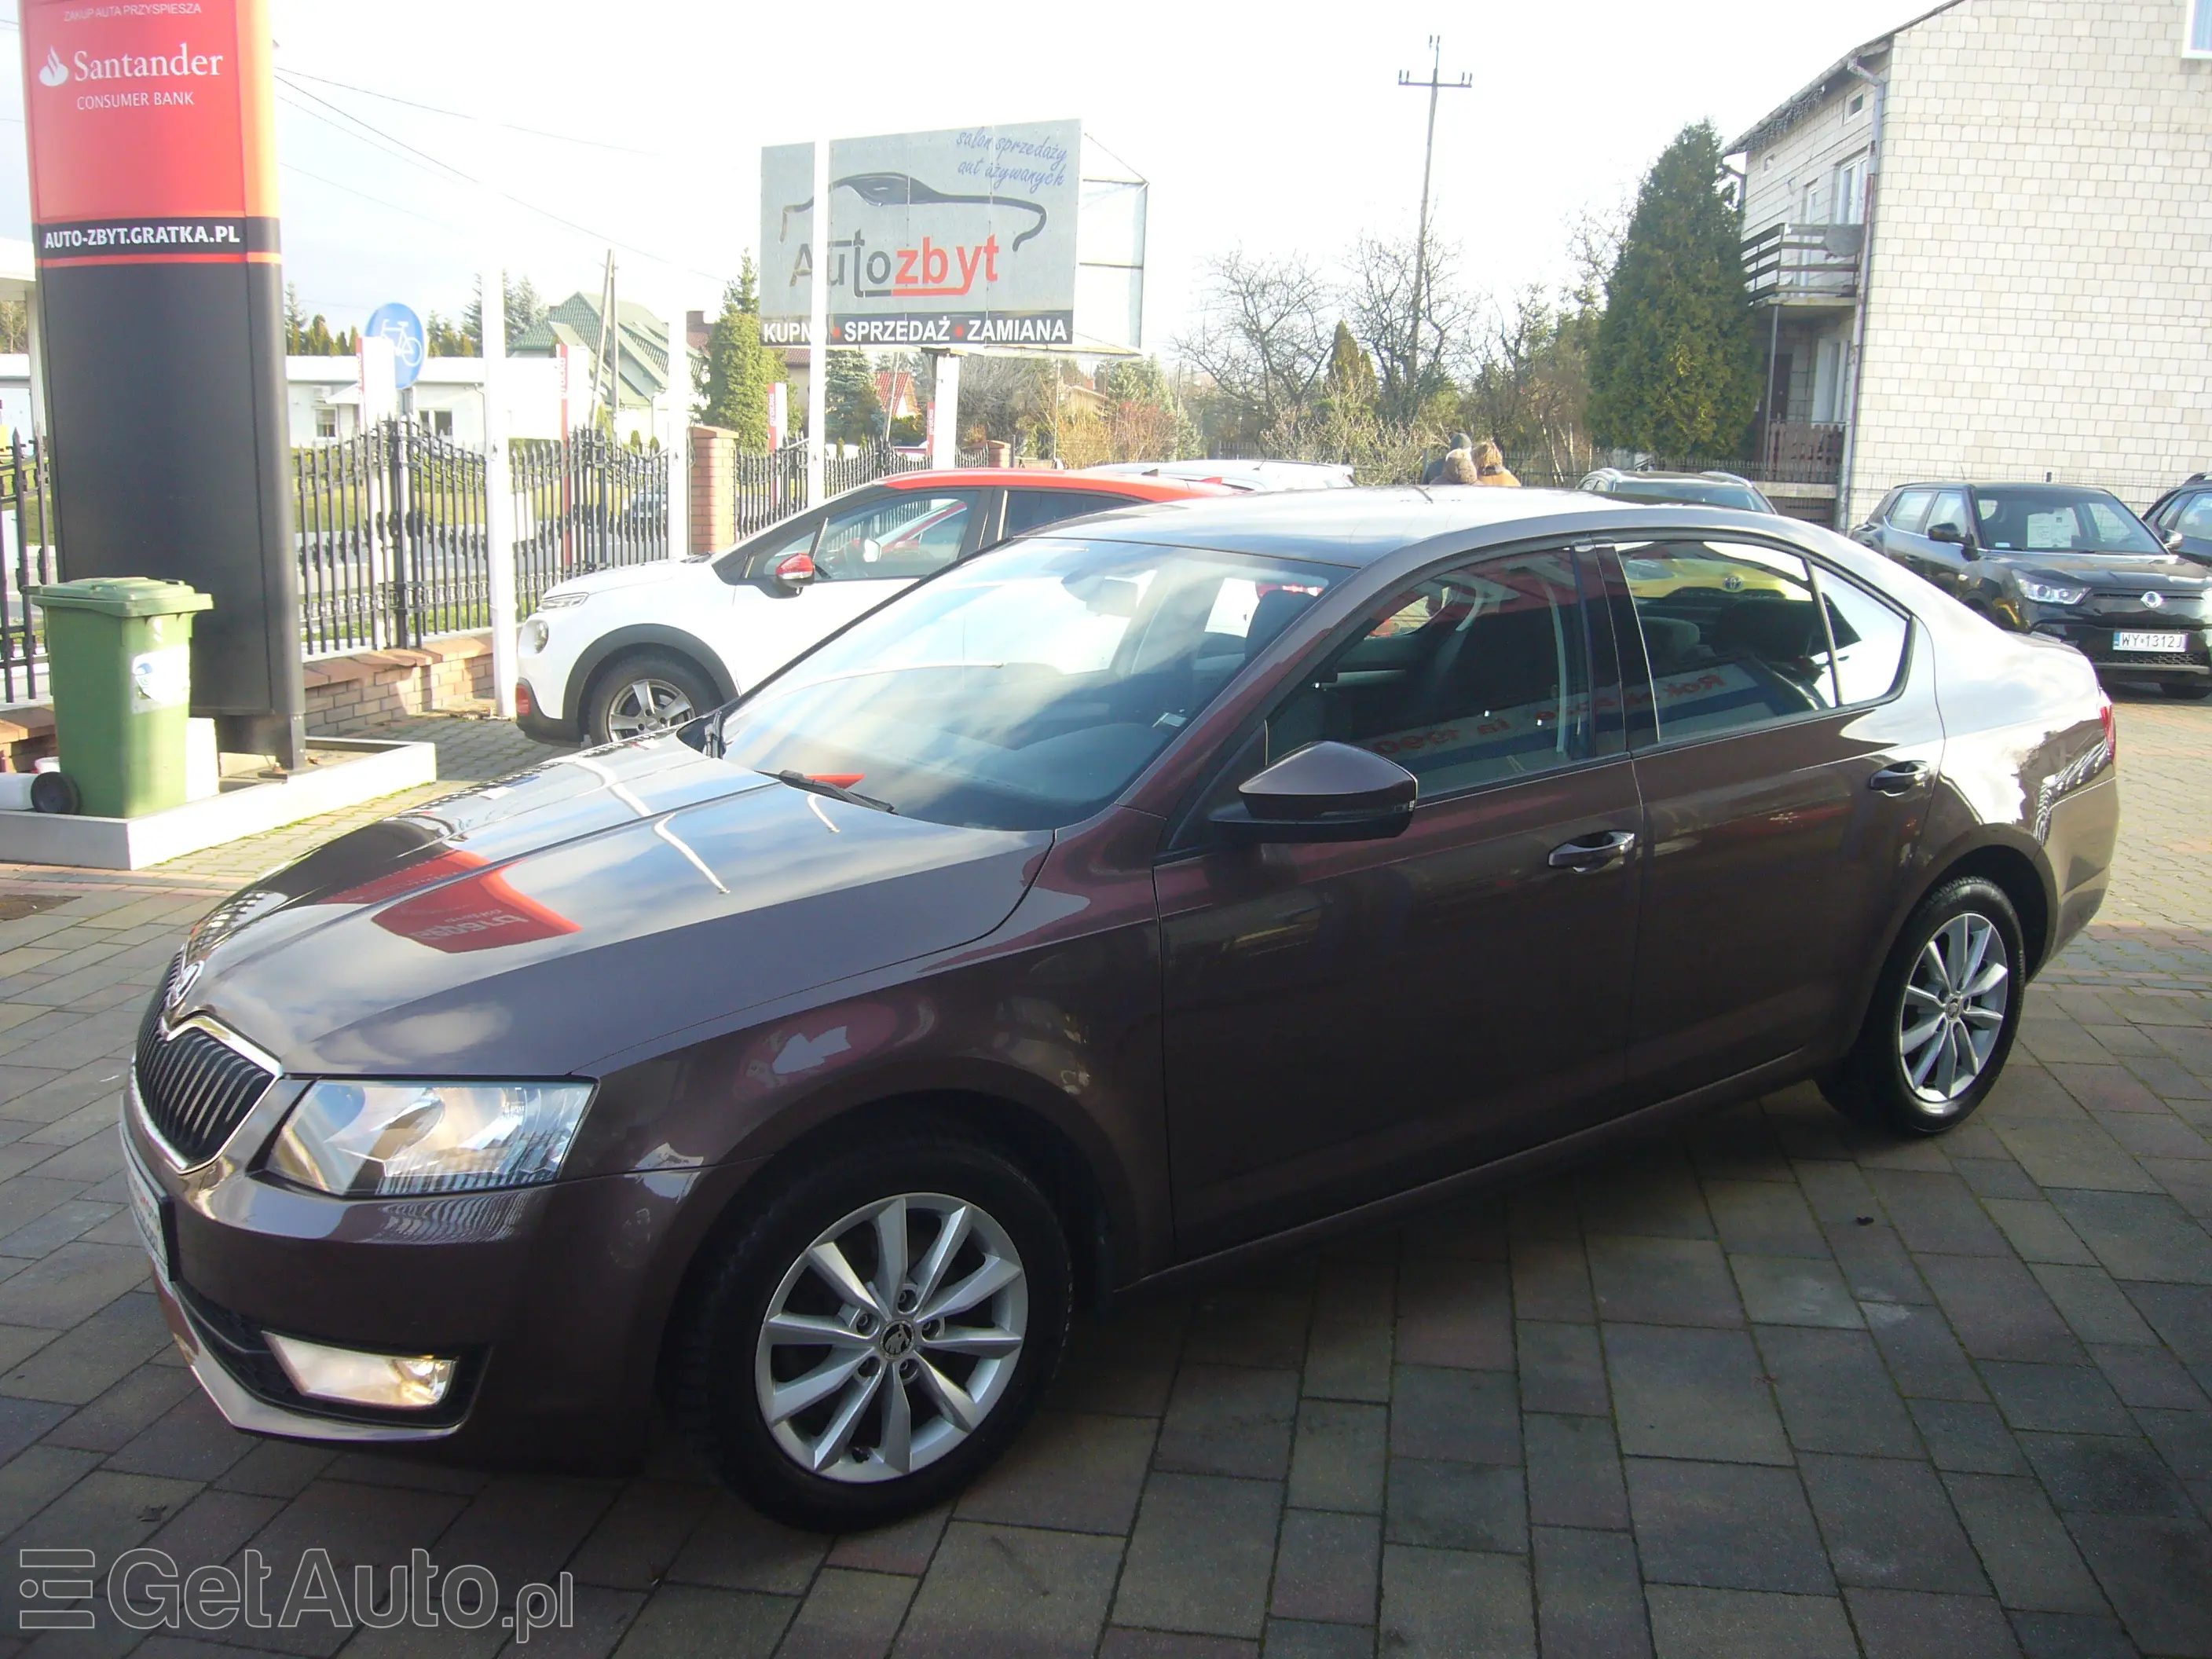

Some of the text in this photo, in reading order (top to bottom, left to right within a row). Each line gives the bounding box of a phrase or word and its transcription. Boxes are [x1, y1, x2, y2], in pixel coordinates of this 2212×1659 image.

[64, 3, 202, 22] ZAKUP AUTA PRZYSPIESZA
[74, 42, 224, 82] Santander
[77, 91, 195, 110] CONSUMER BANK
[956, 126, 1068, 171] salon sprzedaży
[958, 157, 1066, 194] aut używanych
[44, 225, 240, 249] AUTO-ZBYT.GRATKA.PL
[764, 316, 1068, 342] KUPN SPRZEDAŻ ZAMIANA
[2122, 633, 2182, 649] WY 1312J
